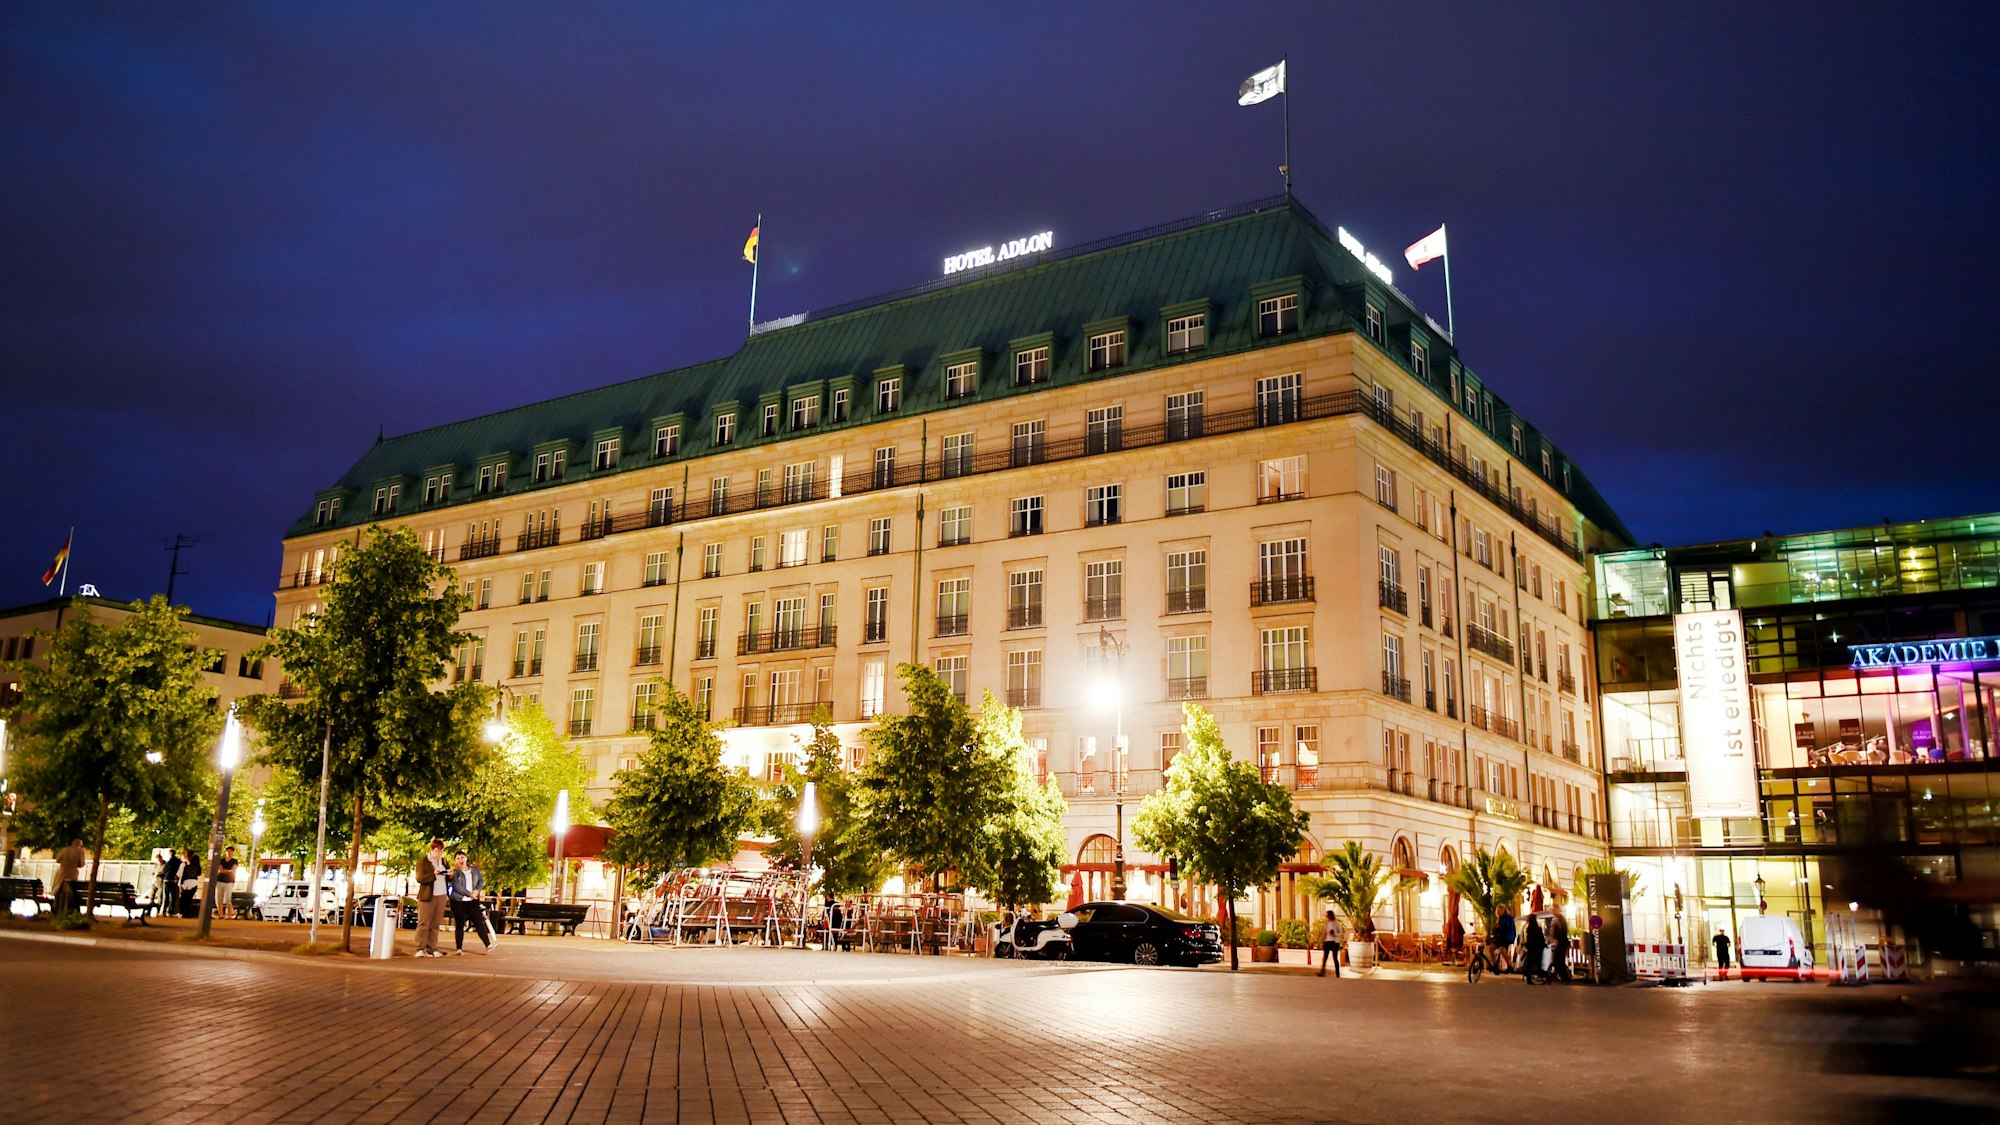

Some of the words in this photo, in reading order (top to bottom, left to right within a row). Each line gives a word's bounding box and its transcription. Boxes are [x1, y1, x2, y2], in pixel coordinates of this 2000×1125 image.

[944, 247, 995, 274] HOTEL
[997, 231, 1052, 261] ADLON
[1685, 621, 1707, 699] Nichts
[1714, 618, 1740, 720] erledigt
[1851, 641, 1988, 667] AKADEMIE
[1724, 728, 1743, 757] ist
